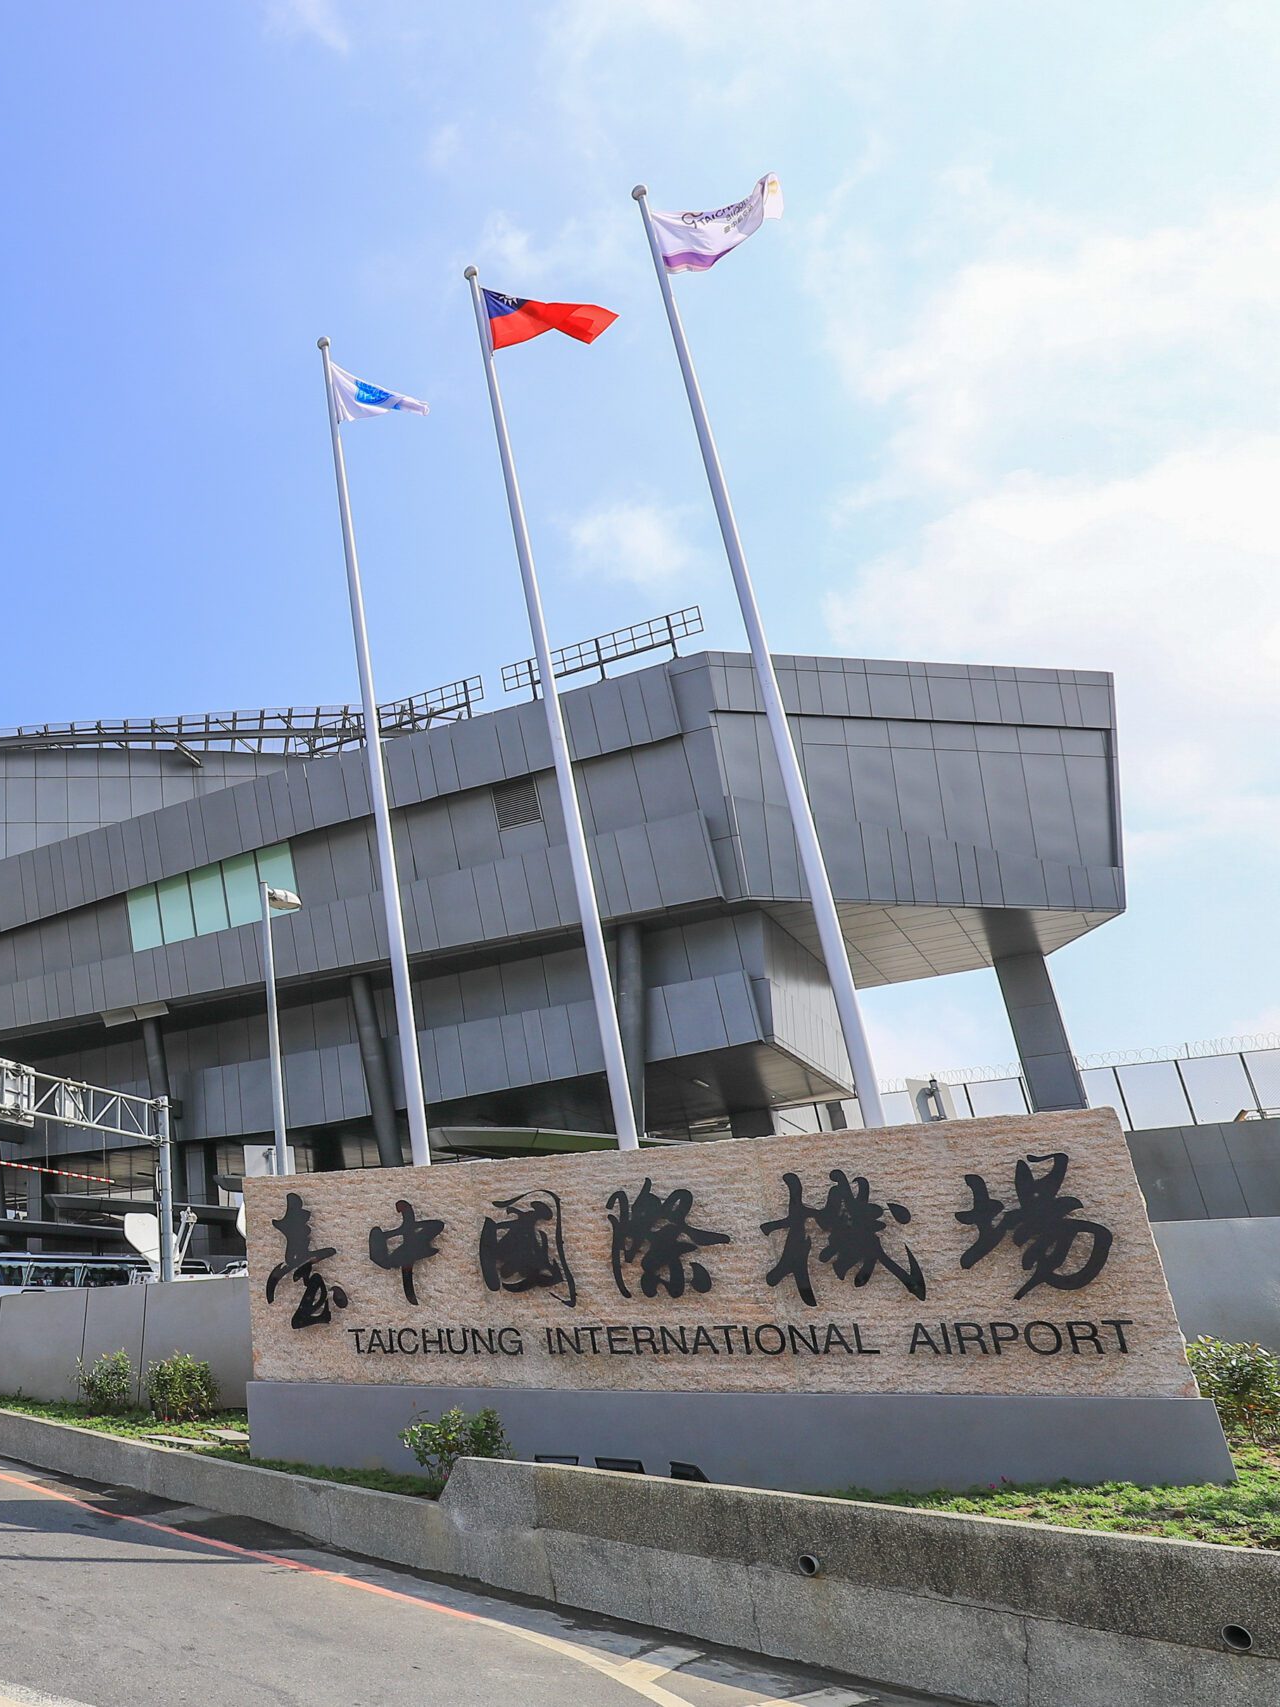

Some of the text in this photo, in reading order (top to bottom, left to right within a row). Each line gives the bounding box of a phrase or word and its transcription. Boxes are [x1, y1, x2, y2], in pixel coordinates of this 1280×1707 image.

[266, 1152, 1113, 1329] 臺中國際機場
[347, 1320, 1134, 1356] TAICHUNG INTERNATIONAL AIRPORT
